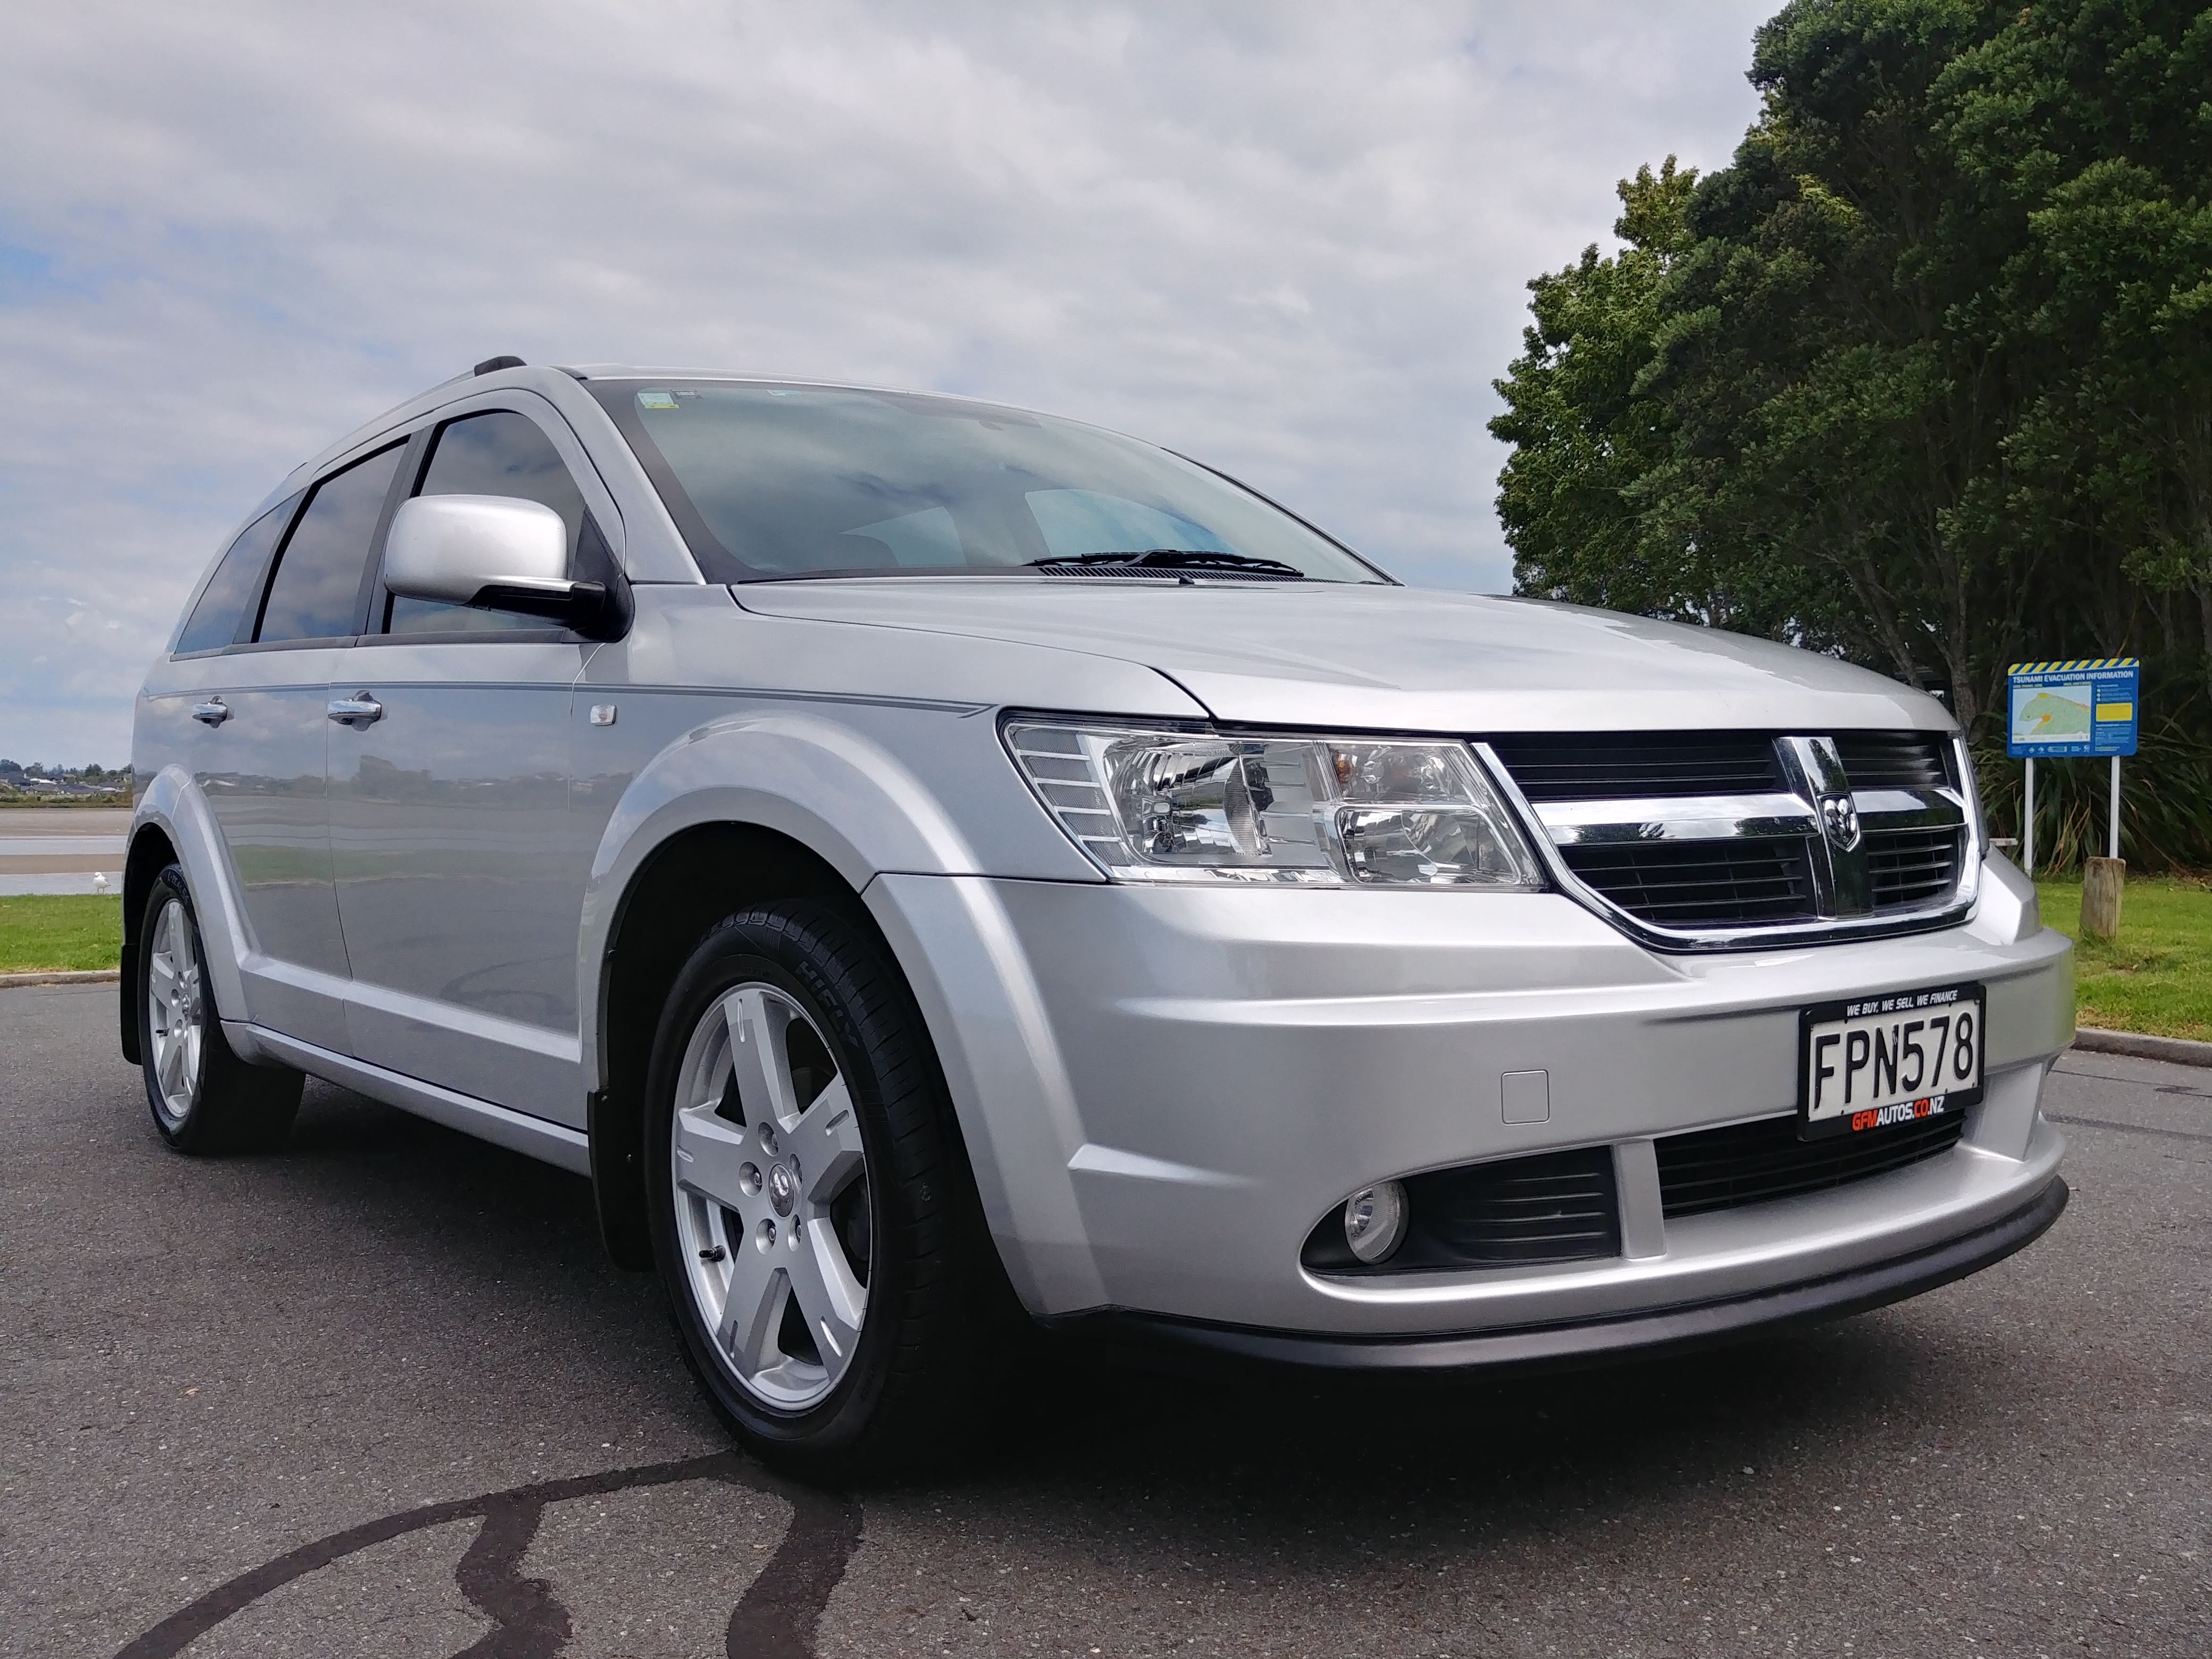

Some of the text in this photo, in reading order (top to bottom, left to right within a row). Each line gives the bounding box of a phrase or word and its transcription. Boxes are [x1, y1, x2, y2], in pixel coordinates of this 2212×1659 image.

[2044, 673, 2085, 682] EVACUATION
[2087, 671, 2133, 680] INFORMATION
[1847, 1004, 1861, 1016] WE
[1862, 1001, 1879, 1014] BUY,
[1882, 999, 1895, 1011] WE
[1917, 994, 1929, 1006] WE
[1930, 990, 1958, 1004] FINANCE
[1814, 1011, 1973, 1109] FPN578
[1852, 1095, 1945, 1131] GFMAUTOS.CO.NZ
